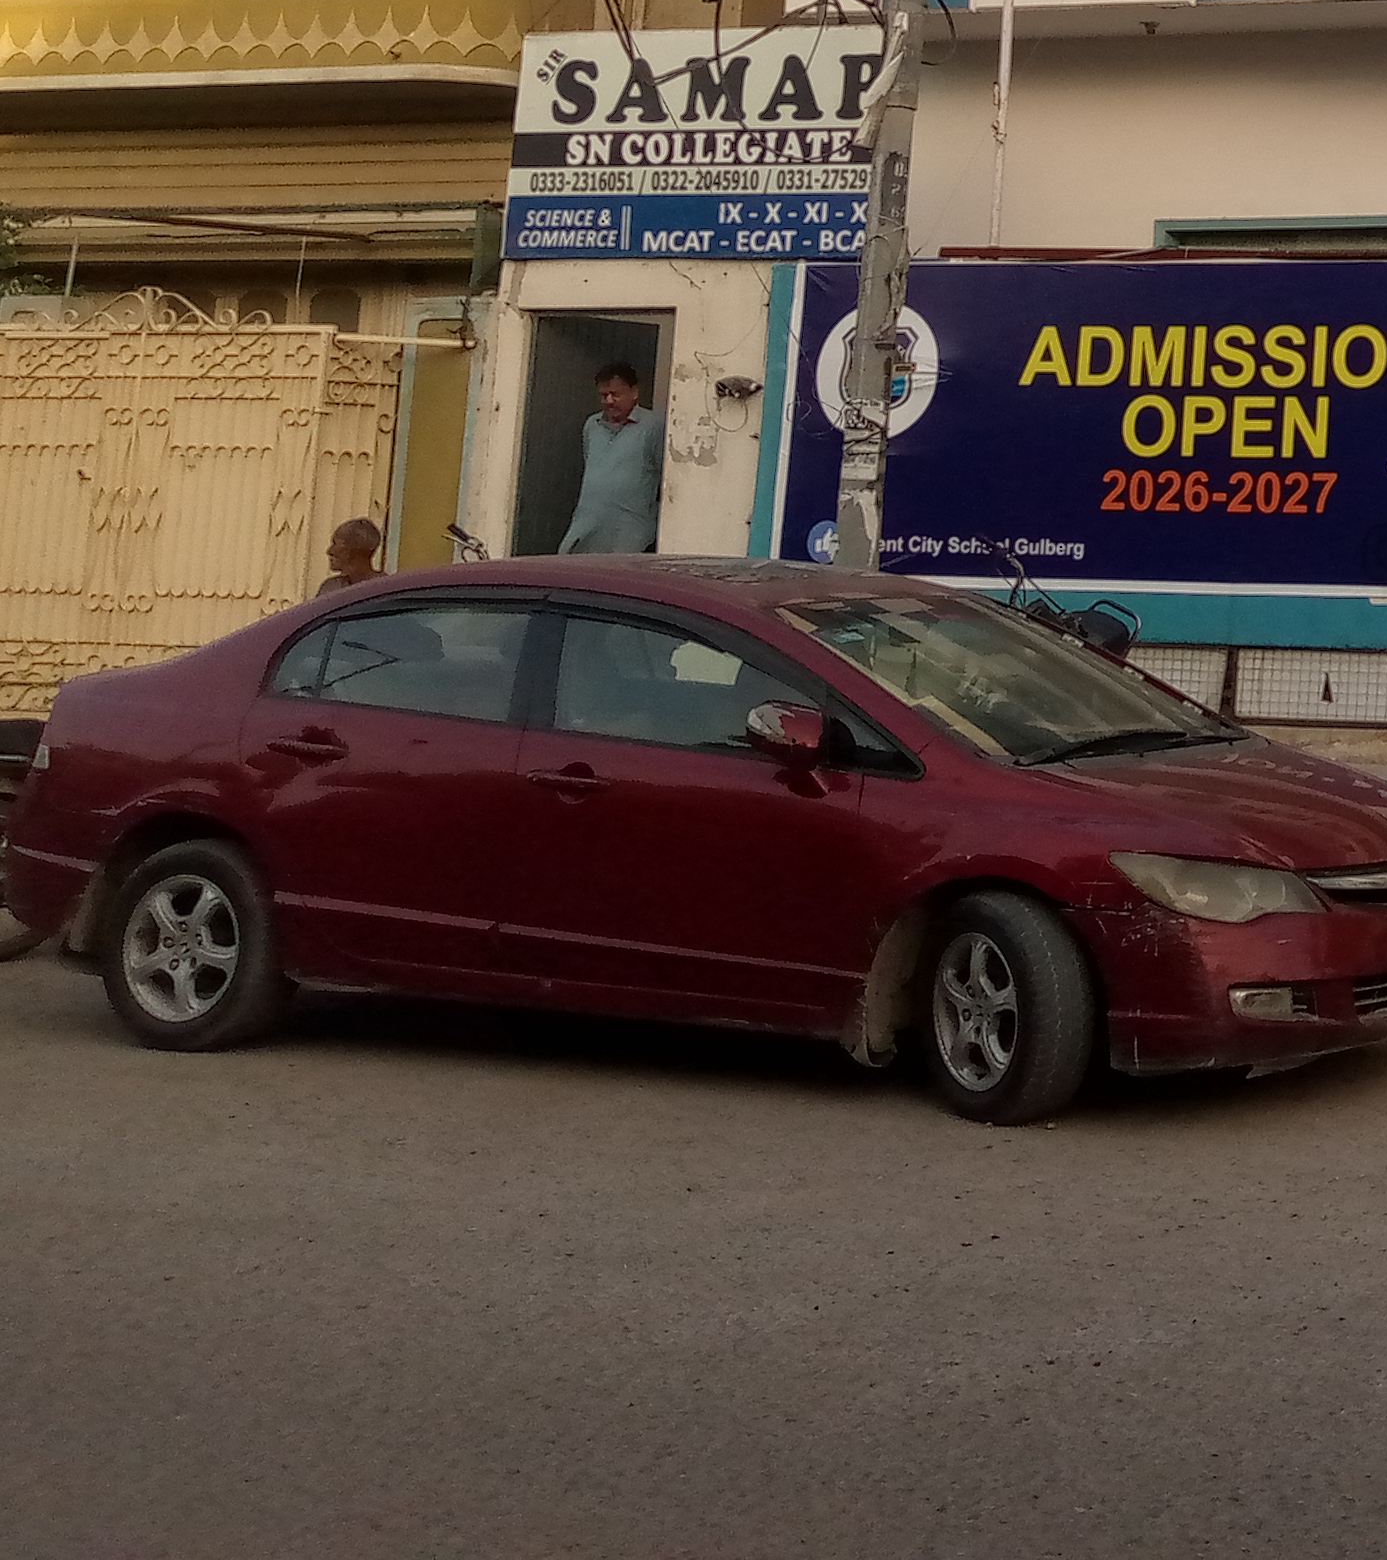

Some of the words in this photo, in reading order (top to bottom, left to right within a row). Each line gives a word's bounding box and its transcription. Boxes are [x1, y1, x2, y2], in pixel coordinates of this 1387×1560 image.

[536, 48, 566, 84] SIR
[565, 132, 613, 165] SN
[621, 130, 852, 164] COLLEGIATE
[530, 171, 635, 193] 0333-2316051
[651, 171, 760, 192] 0322-2045910
[777, 168, 869, 190] 0331-27529
[525, 208, 595, 227] SCIENCE
[597, 208, 612, 226] &
[718, 202, 744, 224] IX
[763, 201, 782, 223] X
[802, 201, 829, 223] XI
[849, 201, 868, 224] X
[517, 228, 618, 249] COMMERCE
[642, 230, 715, 253] MCAT
[737, 230, 798, 252] ECAT
[1121, 394, 1330, 458] OPEN
[1100, 469, 1338, 513] 2026-2027
[878, 536, 904, 552] ent
[908, 535, 943, 557] City
[1015, 537, 1085, 560] Gulberg
